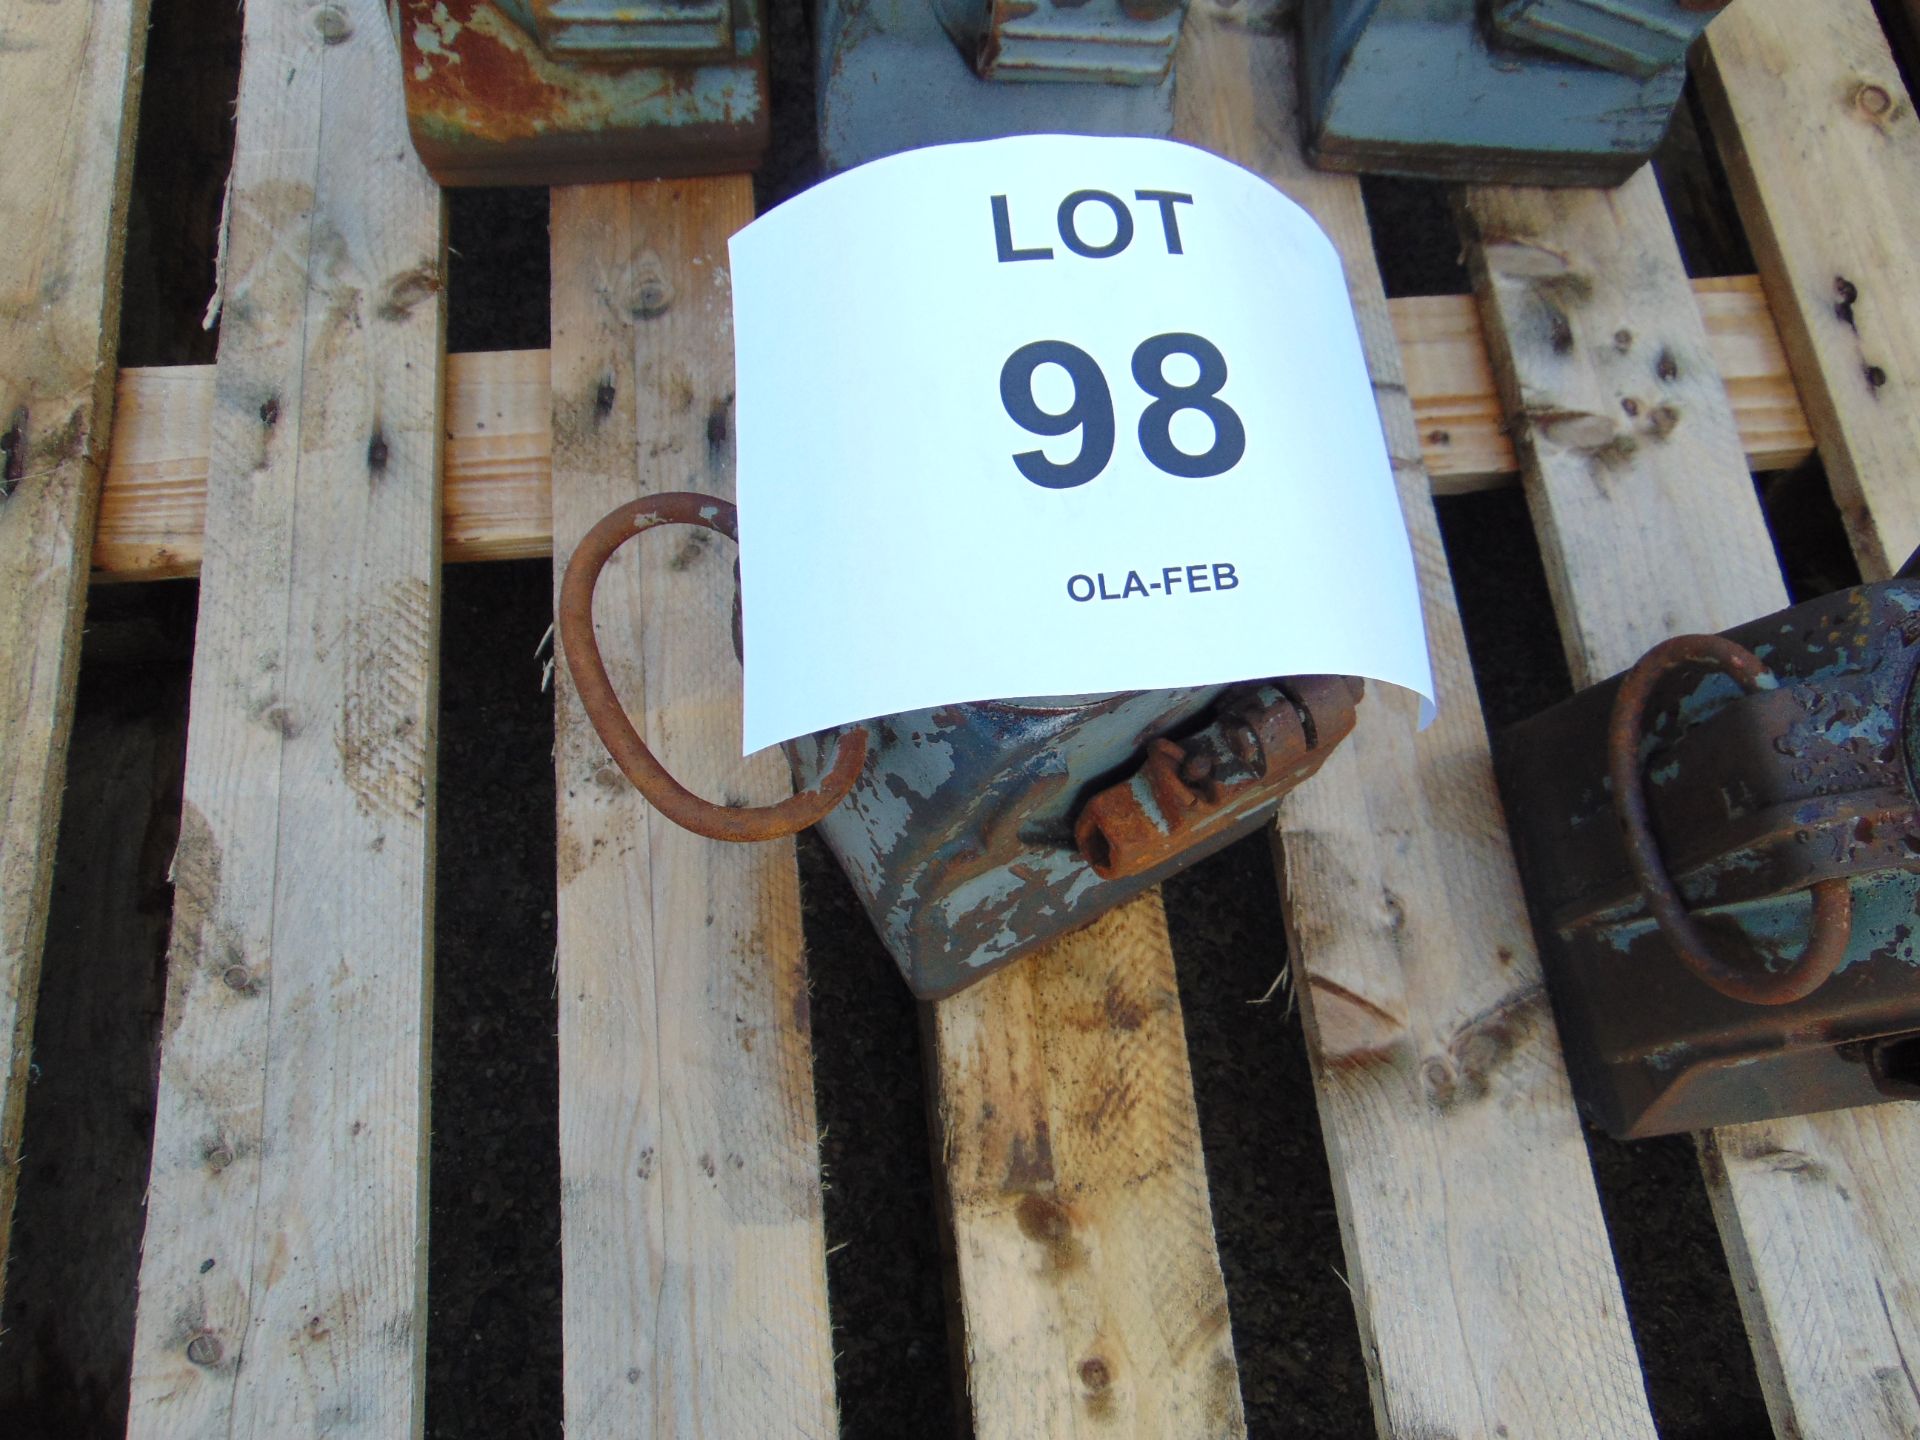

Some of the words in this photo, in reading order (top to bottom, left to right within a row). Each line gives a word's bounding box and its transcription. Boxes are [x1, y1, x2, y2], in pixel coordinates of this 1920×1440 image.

[990, 189, 1194, 263] LOT
[999, 332, 1246, 490] 98
[1066, 562, 1239, 602] OLA-FEB
